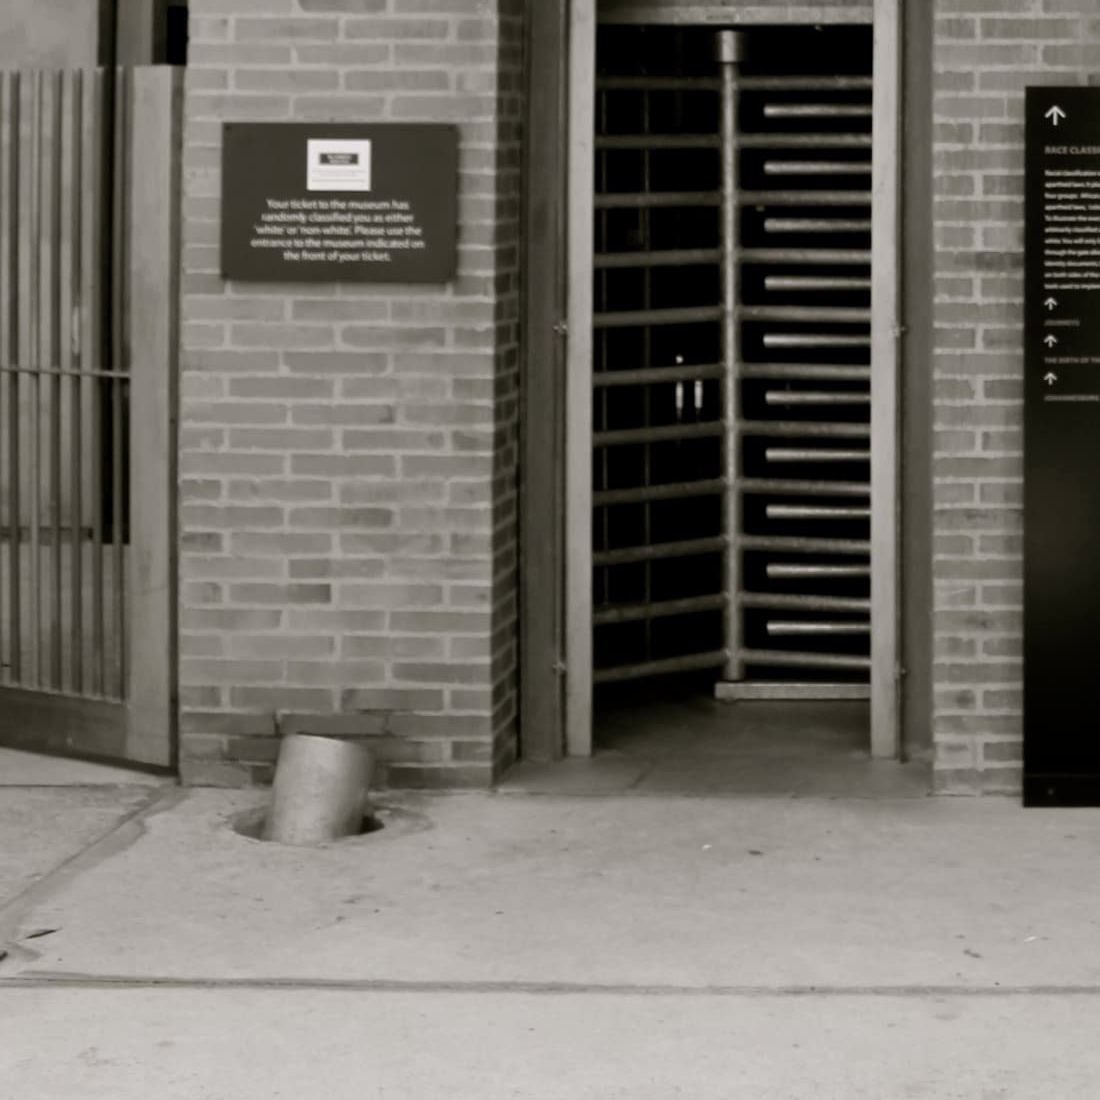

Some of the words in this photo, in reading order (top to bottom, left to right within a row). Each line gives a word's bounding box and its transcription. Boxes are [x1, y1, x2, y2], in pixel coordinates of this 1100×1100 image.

[1044, 146, 1068, 155] RACE
[265, 199, 289, 210] Your
[290, 199, 317, 210] ticket
[318, 199, 329, 210] to
[330, 199, 346, 210] the
[348, 201, 391, 210] museum
[392, 199, 410, 210] has
[261, 212, 307, 224] randomly
[308, 212, 352, 223] classified
[353, 214, 372, 226] you
[374, 214, 384, 223] as
[385, 212, 415, 223] either
[286, 228, 297, 236] or
[354, 225, 385, 236] Please
[386, 228, 404, 237] use
[405, 225, 422, 236] the
[250, 239, 293, 249] entrance
[294, 238, 304, 249] to
[305, 238, 321, 249] the
[322, 240, 364, 249] museum
[366, 238, 410, 249] indicated
[411, 240, 425, 250] on
[283, 250, 301, 261] the
[301, 250, 326, 261] front
[327, 250, 339, 261] of
[339, 252, 361, 264] your
